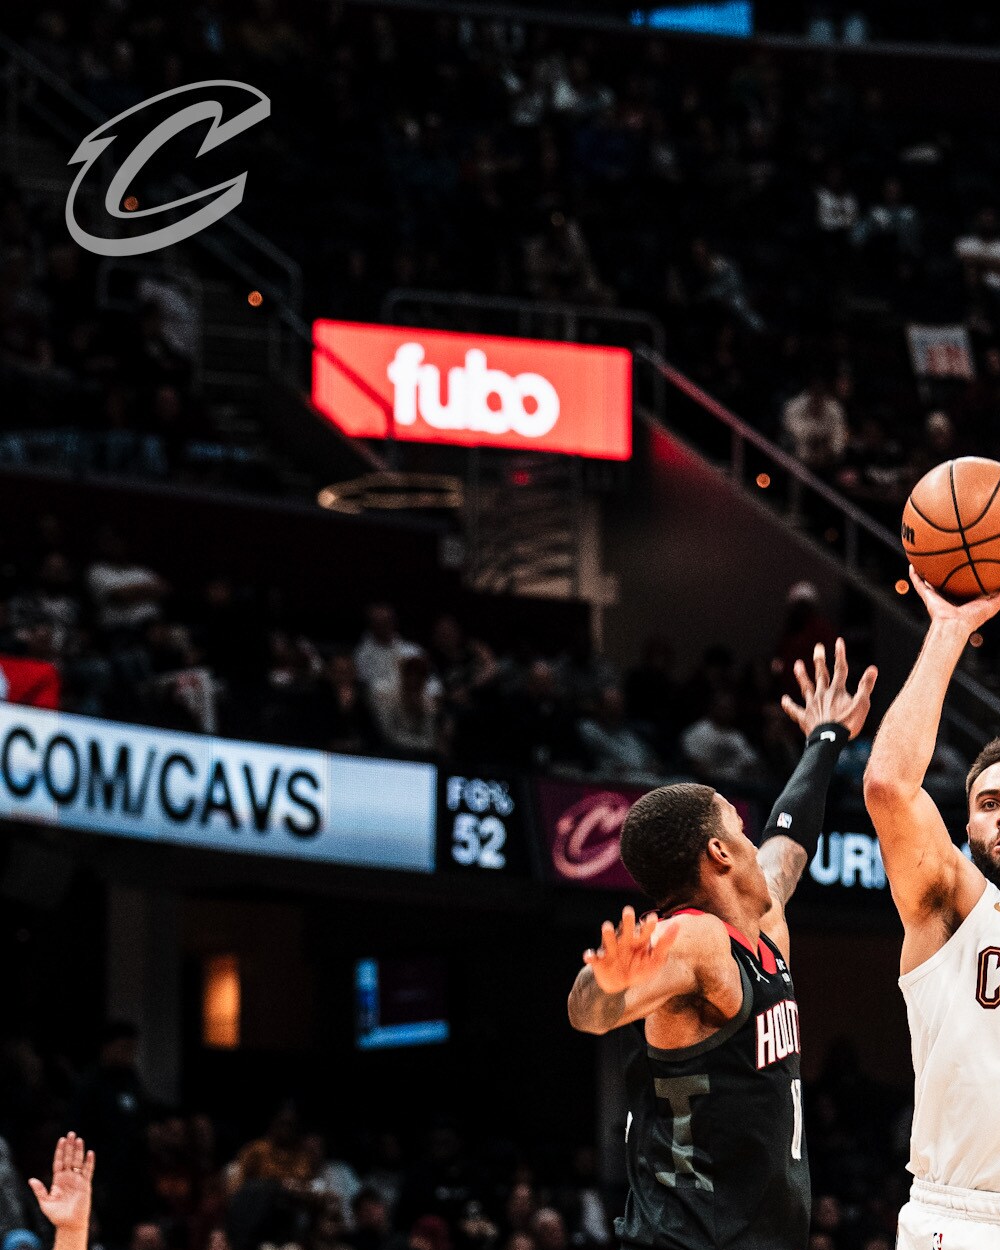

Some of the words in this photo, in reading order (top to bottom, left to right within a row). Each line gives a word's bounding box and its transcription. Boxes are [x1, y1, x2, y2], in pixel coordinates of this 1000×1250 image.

[386, 342, 561, 438] fubo
[2, 727, 323, 838] COM/CAVS
[452, 812, 507, 869] 52
